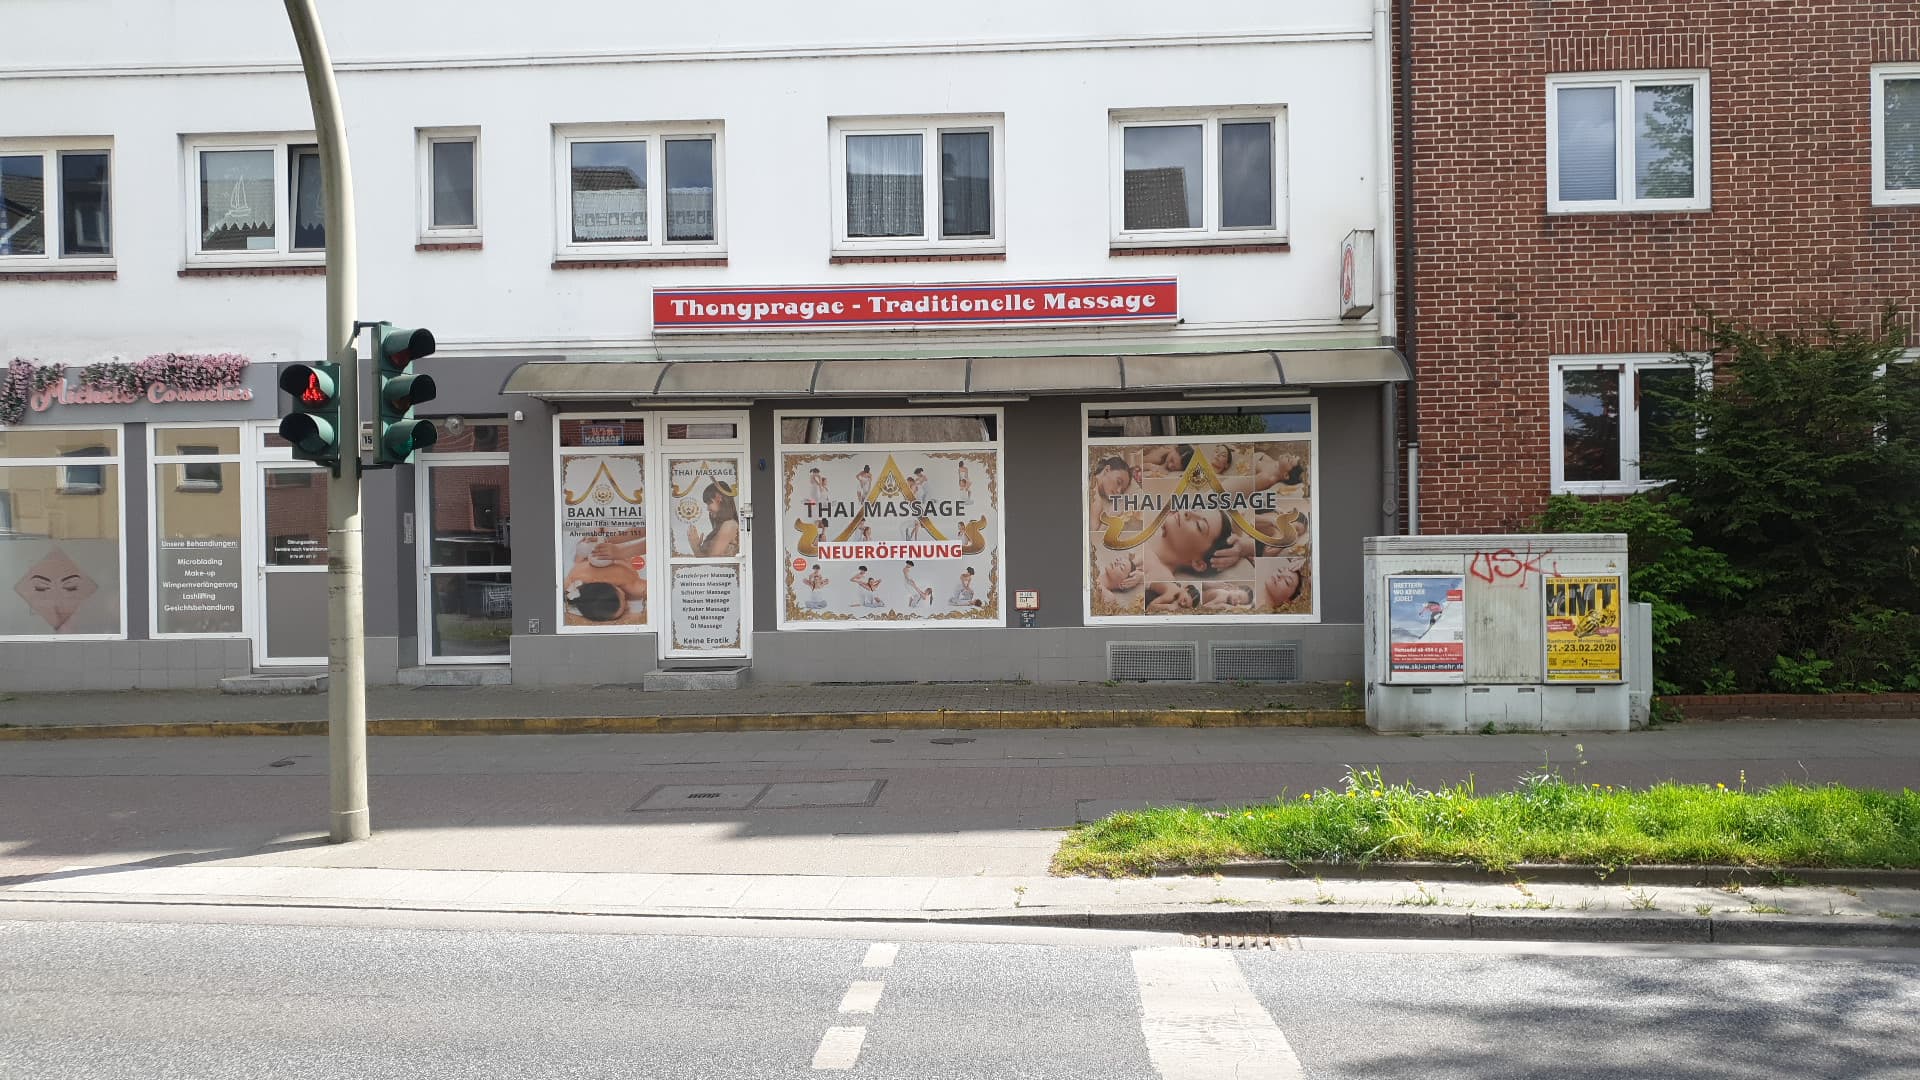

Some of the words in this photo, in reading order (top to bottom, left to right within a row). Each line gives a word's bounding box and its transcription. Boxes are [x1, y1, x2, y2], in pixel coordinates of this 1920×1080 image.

[670, 299, 845, 321] Thongpragae
[867, 294, 1036, 314] Traditionelle
[1043, 292, 1156, 313] Massage
[1109, 493, 1162, 511] THAI
[1171, 492, 1277, 511] MASSAGE
[567, 507, 605, 518] BAAN
[610, 506, 642, 517] THAI
[804, 501, 855, 518] THAI
[864, 500, 966, 518] MASSAGE
[565, 520, 593, 528] Original
[610, 520, 645, 528] Massagen
[818, 542, 962, 560] NEUERÖFFNUNG
[177, 558, 223, 566] Microblading
[164, 604, 235, 612] Gesichtsbehandlung
[1546, 643, 1617, 652] 21.-23.02.2020
